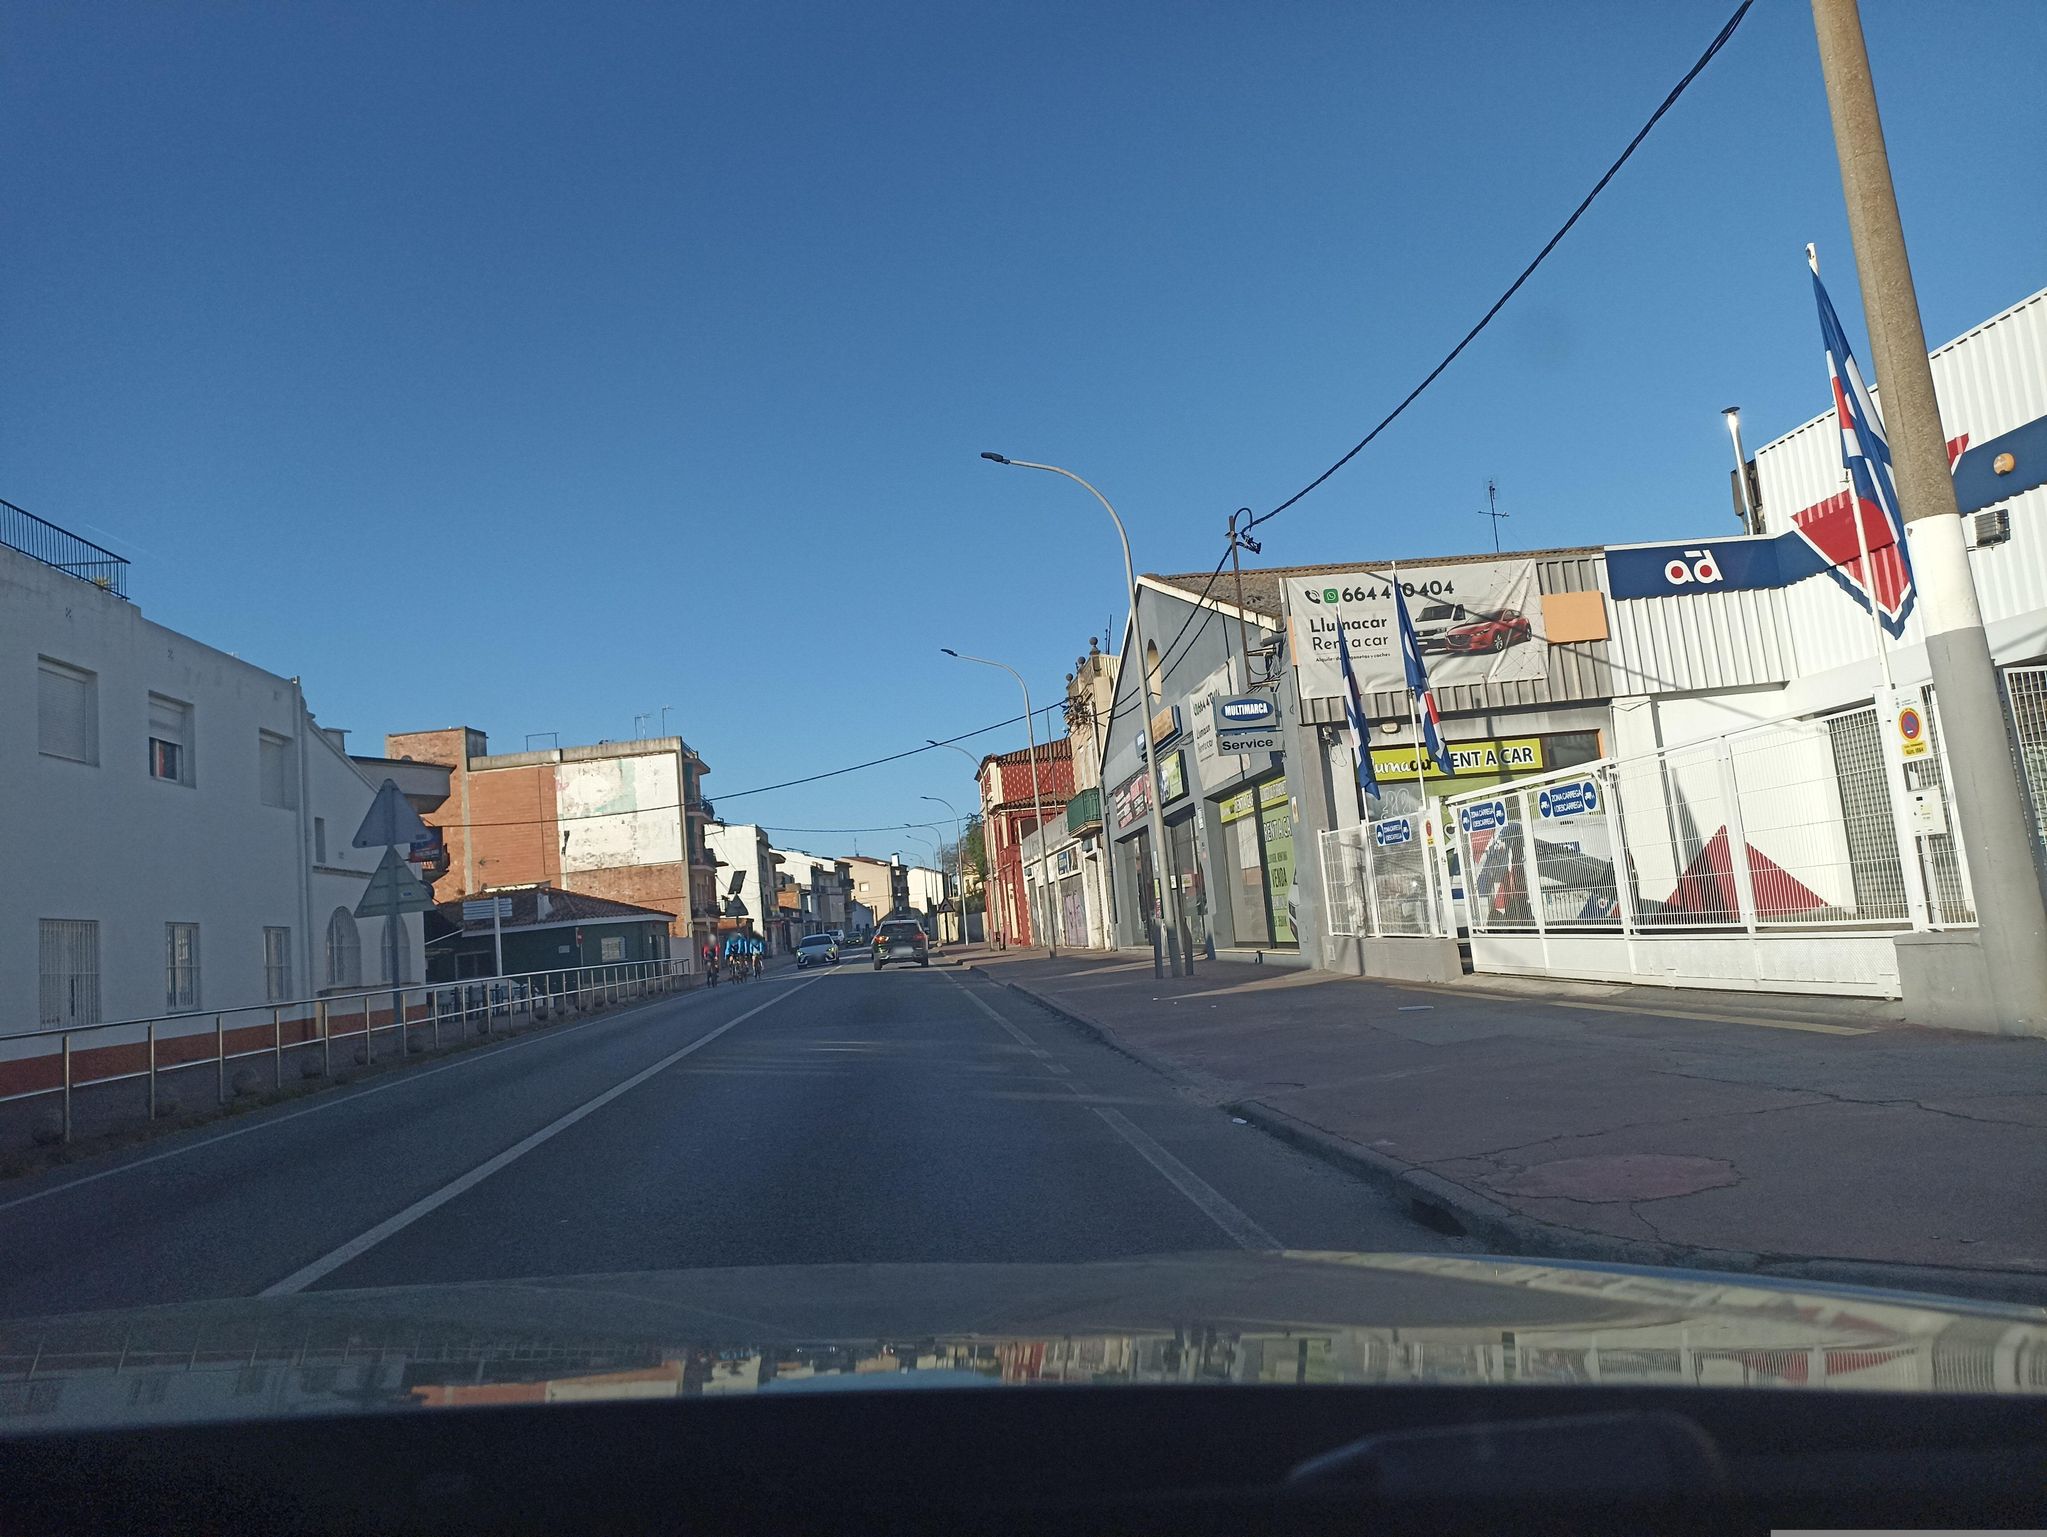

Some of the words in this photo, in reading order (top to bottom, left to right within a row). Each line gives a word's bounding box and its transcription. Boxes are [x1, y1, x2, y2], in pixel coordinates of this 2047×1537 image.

[1342, 586, 1377, 603] 664
[1381, 582, 1415, 600] 40
[1419, 580, 1455, 597] 404
[1351, 638, 1361, 648] a
[1364, 636, 1389, 648] car
[1224, 703, 1268, 716] MULTIMARCA
[1222, 739, 1273, 751] Service
[1452, 751, 1482, 769] ENT
[1485, 750, 1497, 766] A
[1500, 747, 1533, 765] CAR
